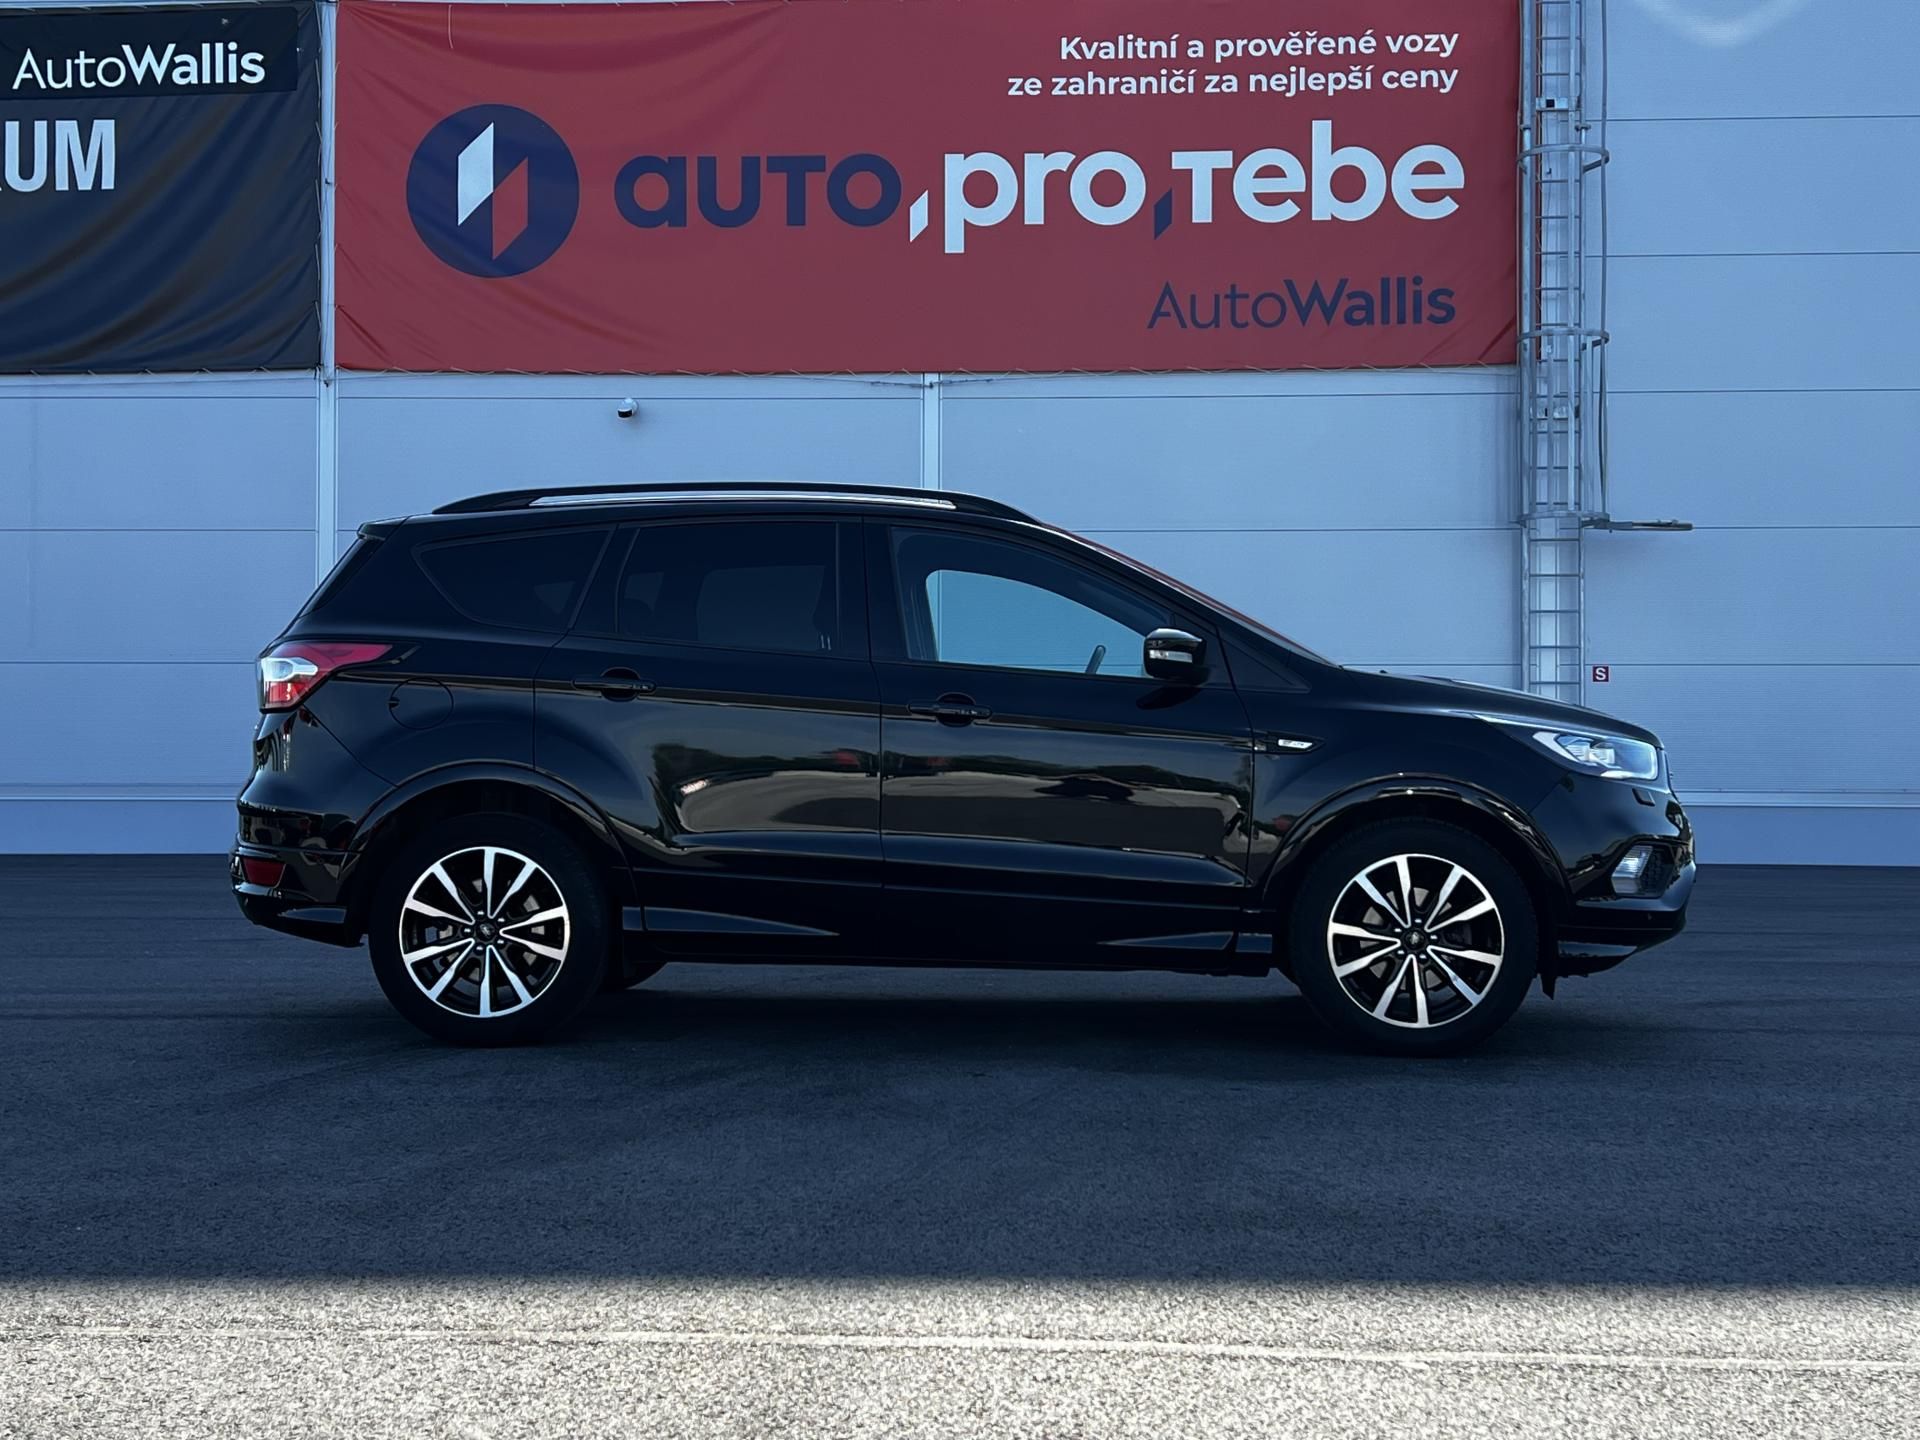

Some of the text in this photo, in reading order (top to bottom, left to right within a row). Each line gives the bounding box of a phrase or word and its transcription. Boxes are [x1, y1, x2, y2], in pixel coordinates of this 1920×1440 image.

[12, 42, 266, 90] AutoWallis
[1061, 29, 1459, 64] Kvalitní a prověřené vozy
[1008, 64, 1459, 97] ze zahraničí za nejlepší ceny
[0, 119, 116, 192] UM
[1147, 276, 1457, 330] AutoWallis
[1595, 667, 1607, 681] S
